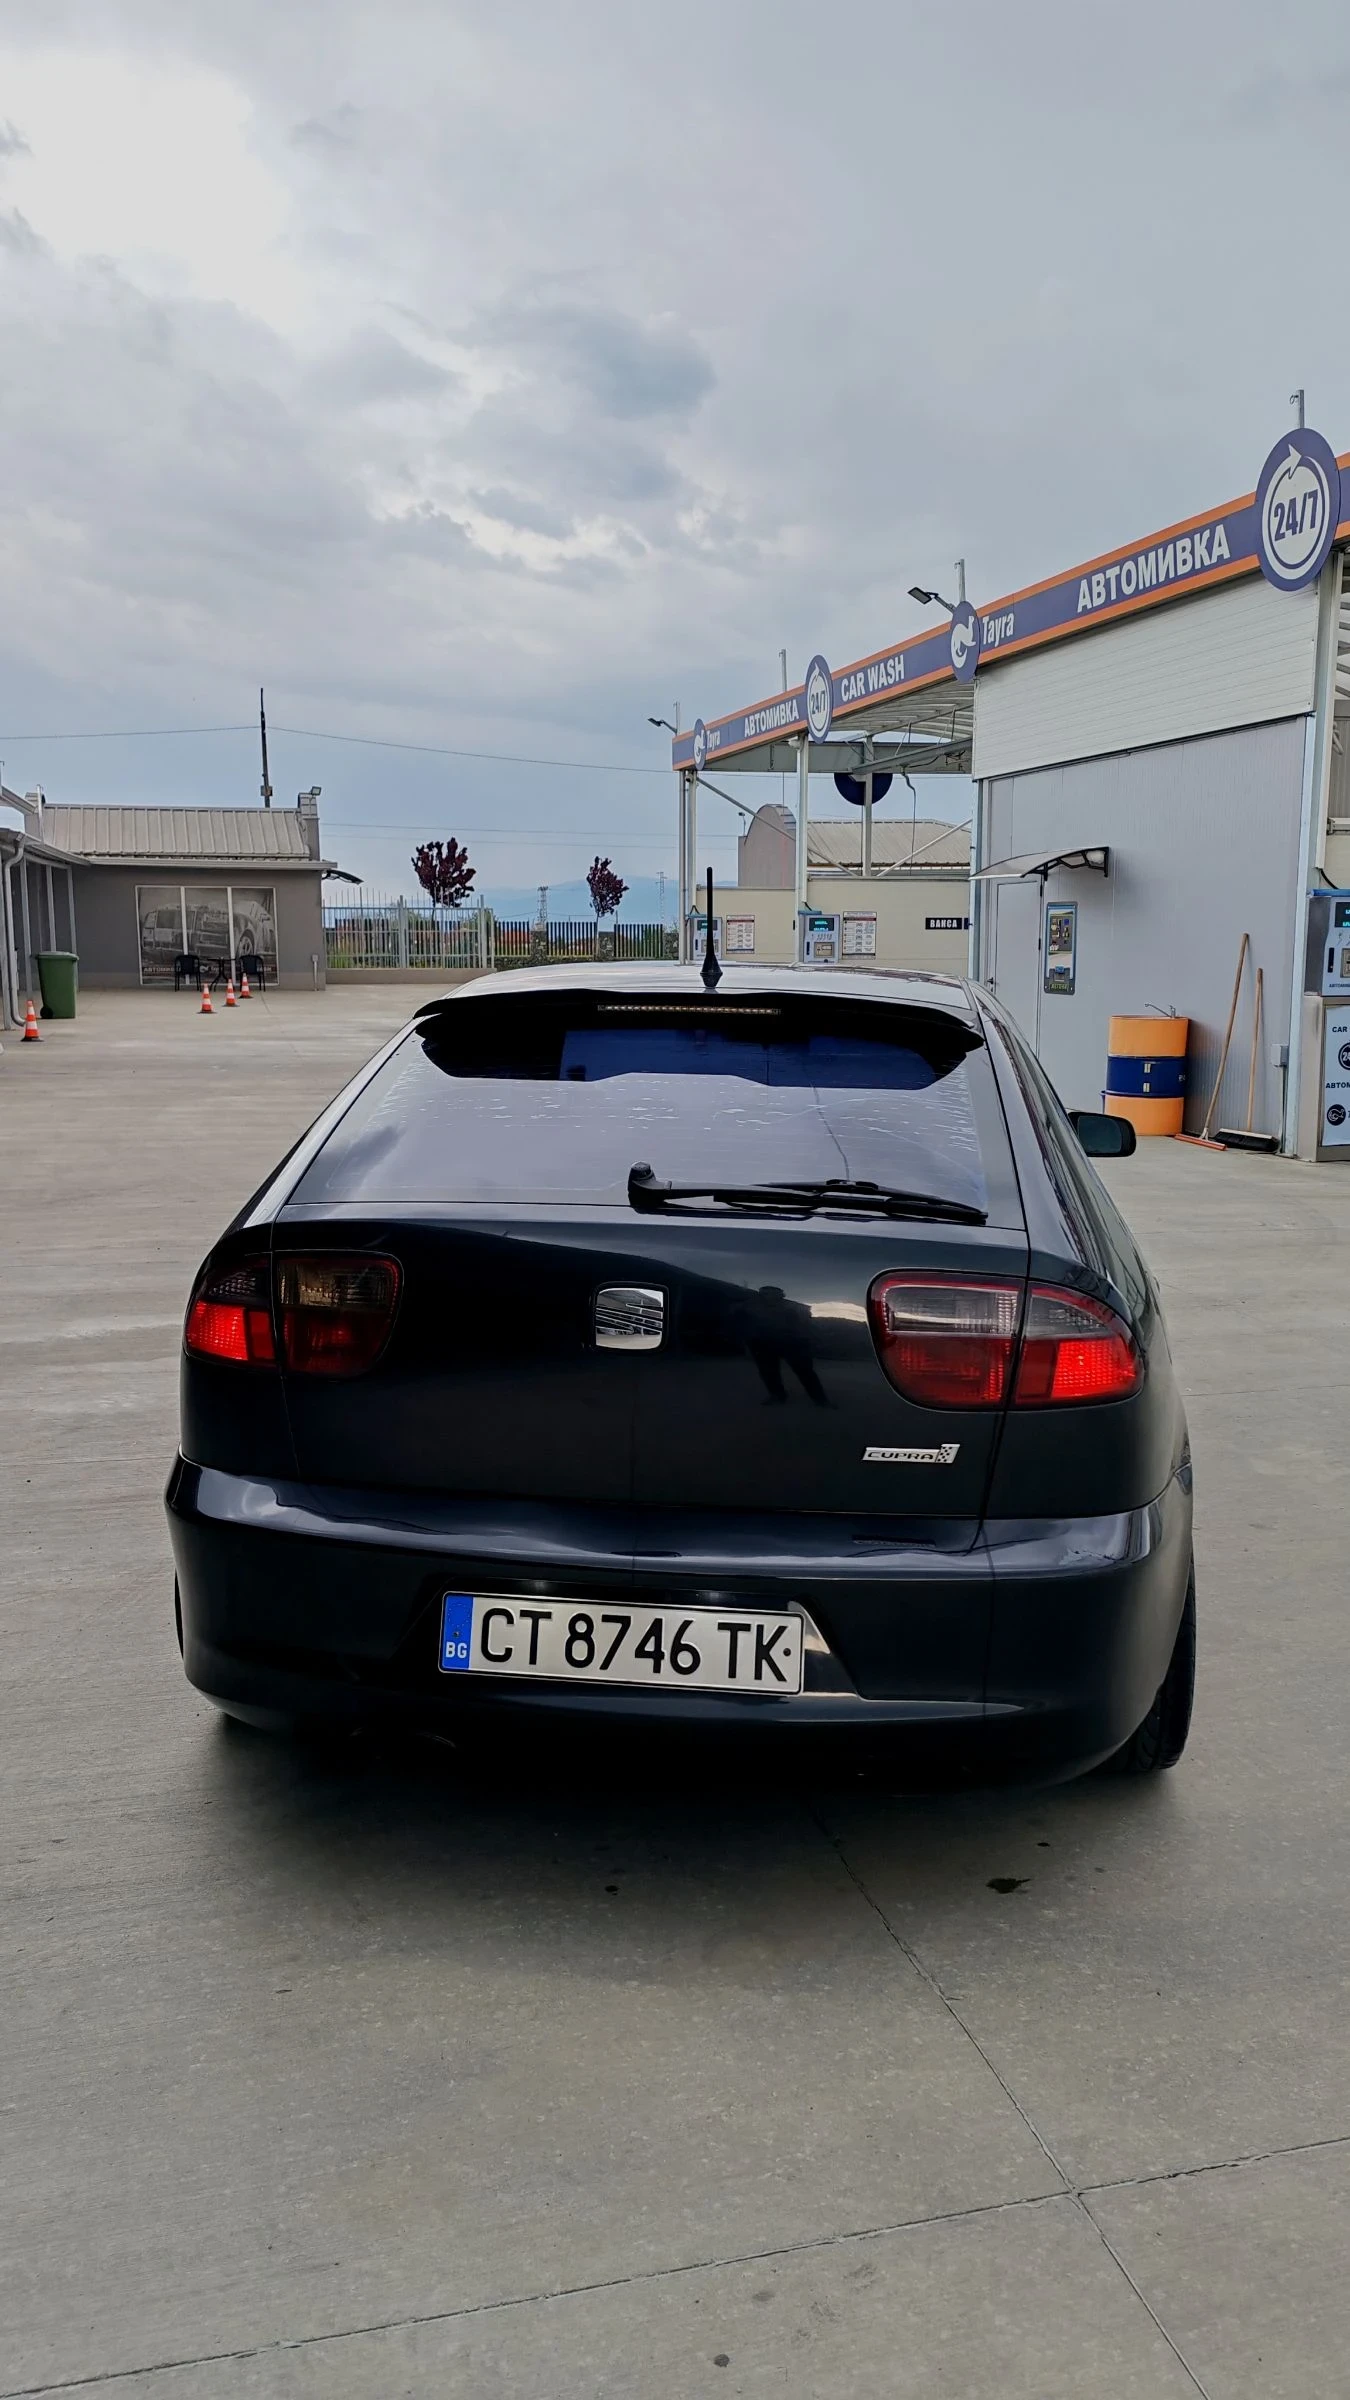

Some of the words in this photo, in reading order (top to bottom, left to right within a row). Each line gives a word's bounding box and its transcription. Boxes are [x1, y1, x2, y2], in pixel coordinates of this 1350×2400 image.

[1273, 489, 1318, 542] 24/7
[1077, 524, 1231, 613] АВТОМИВКА
[982, 613, 1014, 647] Tayra
[841, 674, 866, 702] CAR
[867, 654, 905, 692] WASH
[744, 699, 799, 738] АВТОМИВКА
[810, 690, 826, 715] 24/7
[706, 730, 721, 751] Tayra
[867, 1451, 934, 1460] CUPRA
[445, 1641, 468, 1659] BG
[480, 1607, 553, 1666] CT
[564, 1612, 701, 1676] 8746
[717, 1621, 788, 1682] TK
